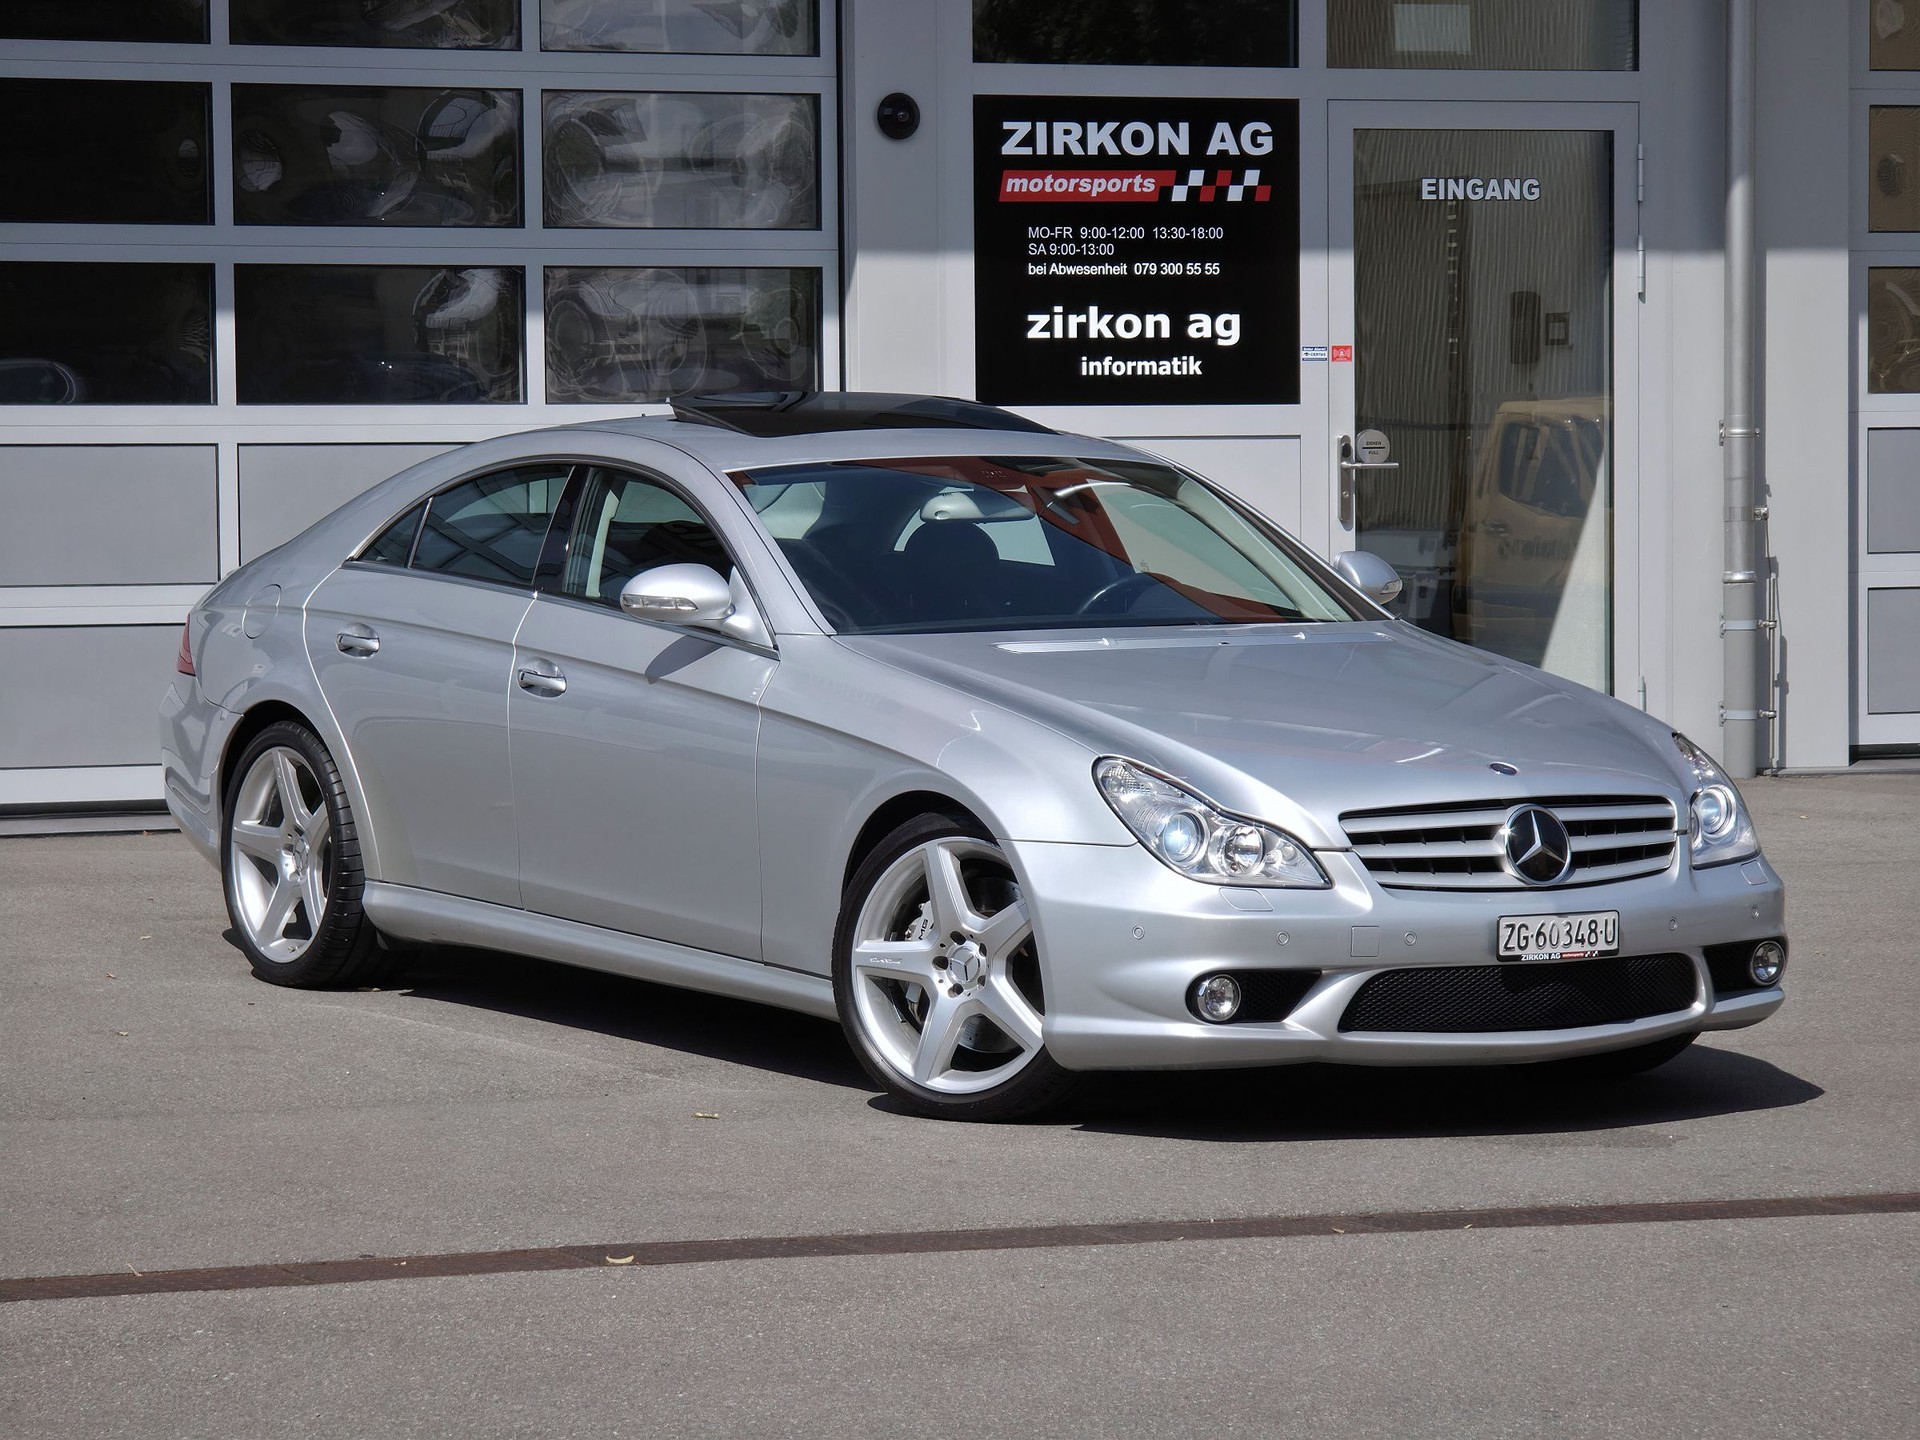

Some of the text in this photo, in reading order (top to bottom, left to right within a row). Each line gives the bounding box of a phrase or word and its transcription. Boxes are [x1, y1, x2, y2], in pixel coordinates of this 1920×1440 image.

[1001, 121, 1273, 156] ZIRKON AG
[1005, 173, 1156, 197] motorsports
[1421, 178, 1540, 201] EINGANG
[1028, 226, 1224, 239] MO-FR 9:00-12:00 13:30-18:00
[1028, 243, 1115, 256] SA 9:00-13:00
[1028, 262, 1221, 276] bei Abwesenheit 079 300 55 55
[1026, 305, 1241, 346] zirkon ag
[1081, 355, 1203, 376] informatik
[1520, 953, 1549, 961] ZIRKON
[1550, 952, 1561, 960] AG
